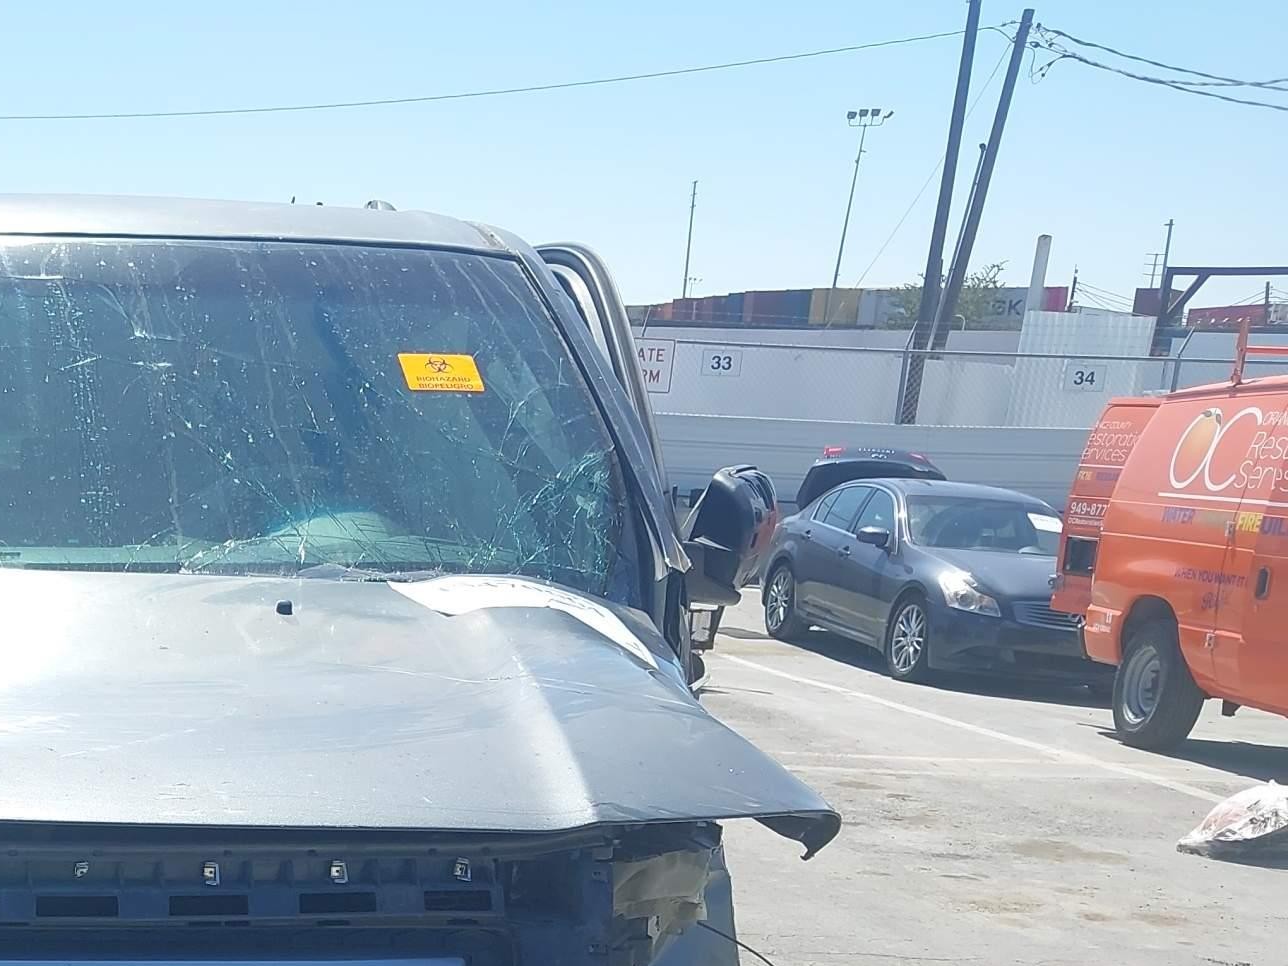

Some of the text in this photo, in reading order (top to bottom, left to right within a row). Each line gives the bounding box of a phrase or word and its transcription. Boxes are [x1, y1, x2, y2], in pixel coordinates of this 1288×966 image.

[638, 347, 665, 363] ATE
[710, 355, 733, 371] 33
[416, 375, 471, 383] BIOHAZARD
[1073, 370, 1096, 386] 34
[1081, 446, 1128, 462] ervices
[1070, 501, 1108, 517] 949-877
[1235, 512, 1264, 533] FIRE
